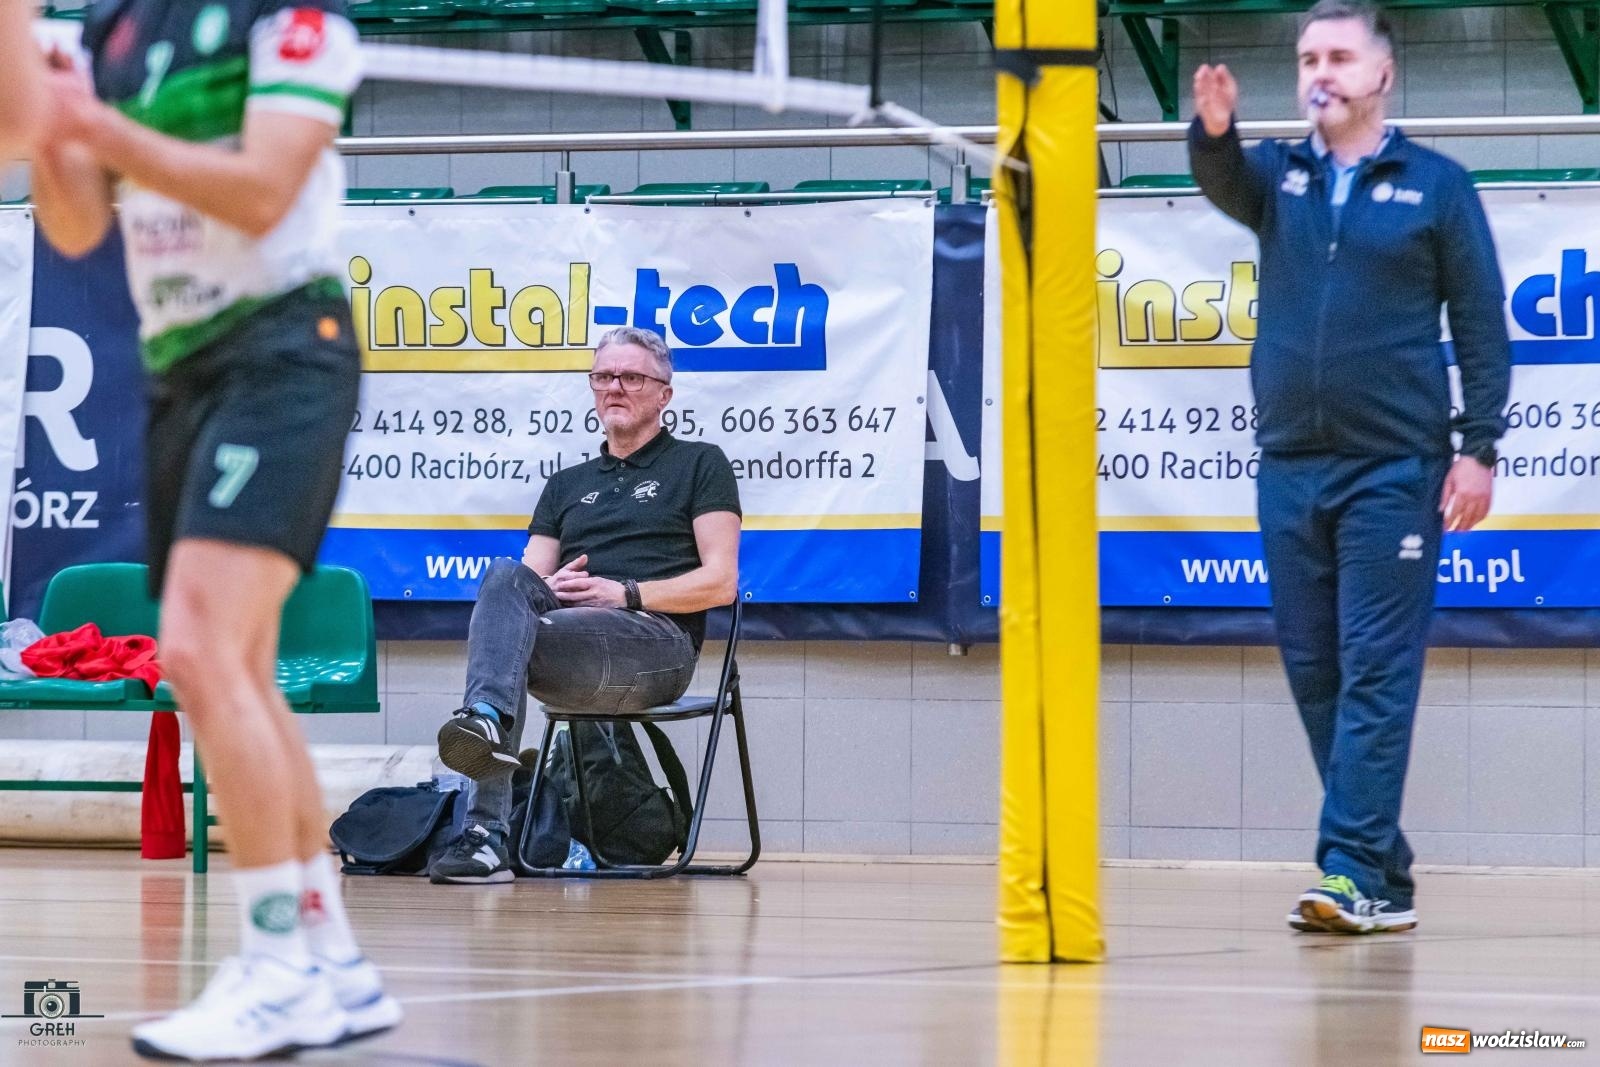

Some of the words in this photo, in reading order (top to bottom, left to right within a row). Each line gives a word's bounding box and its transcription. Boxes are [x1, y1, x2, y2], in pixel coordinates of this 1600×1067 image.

[349, 256, 829, 372] instal-tech
[373, 409, 425, 435] 414
[433, 409, 464, 436] 92
[473, 407, 513, 437] 88,
[528, 409, 573, 436] 502
[721, 406, 775, 433] 606
[783, 406, 837, 435] 363
[848, 406, 897, 434] 647
[1118, 407, 1177, 434] 414
[1186, 407, 1220, 434] 92
[1505, 401, 1562, 429] 606
[207, 442, 260, 508] 7
[411, 451, 530, 483] Racibórz,
[730, 450, 851, 480] endorffa
[861, 452, 875, 478] 2
[13, 477, 99, 529] ÓRZ
